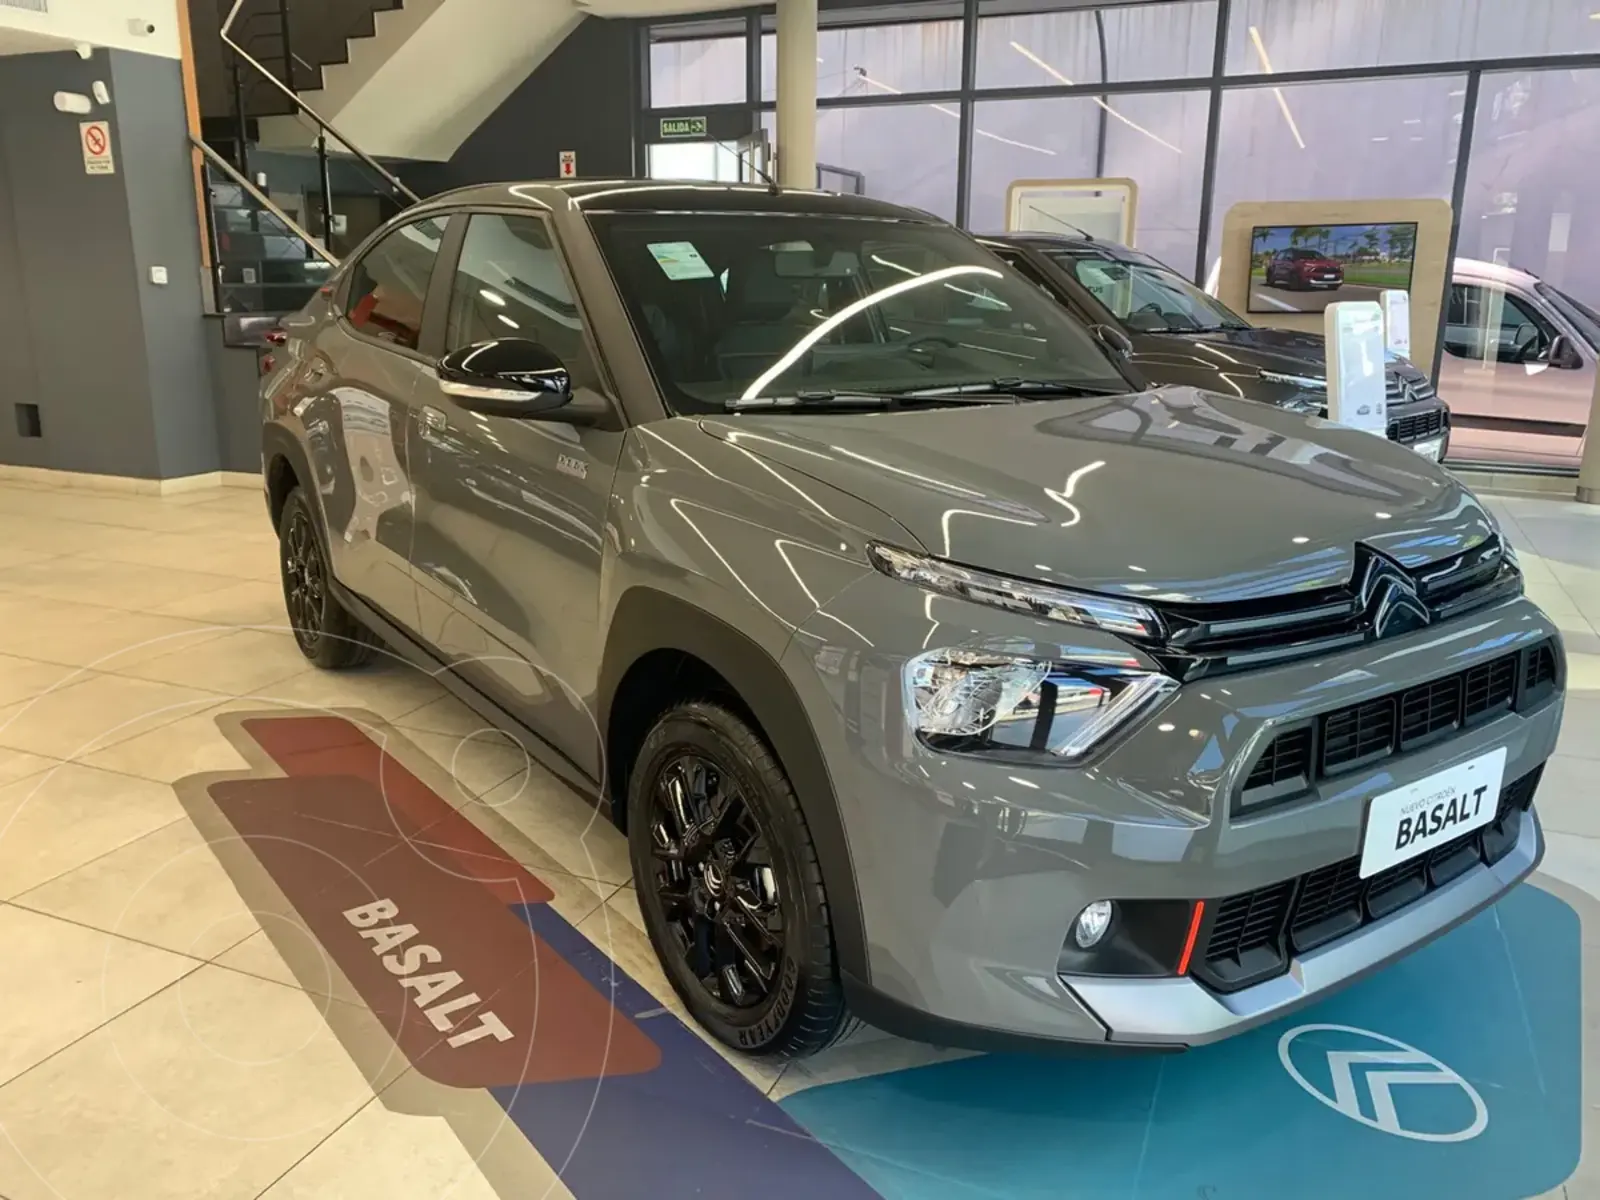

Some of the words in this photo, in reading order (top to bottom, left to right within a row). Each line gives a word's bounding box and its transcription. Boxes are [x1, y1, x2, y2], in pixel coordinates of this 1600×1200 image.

[663, 121, 690, 133] SALIDA
[1395, 785, 1487, 850] BASALT
[342, 898, 515, 1048] BASALT
[738, 956, 797, 1046] GOODYEAR
